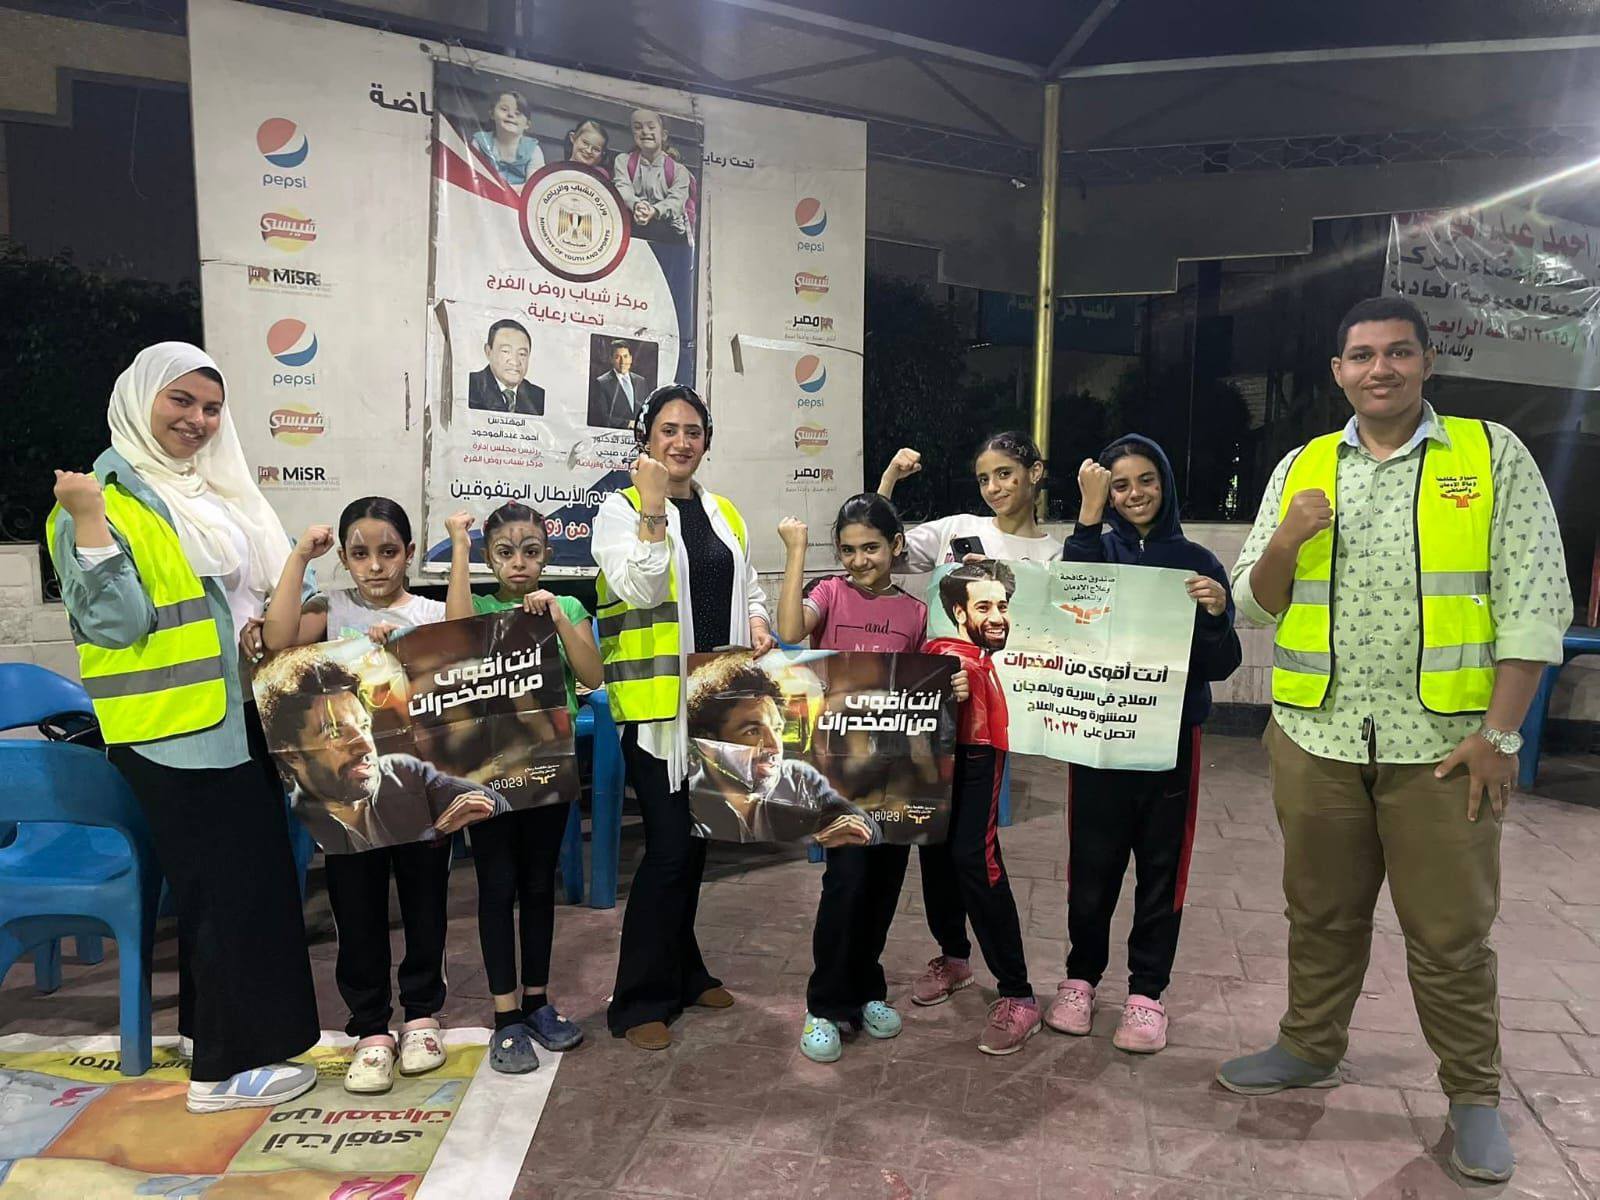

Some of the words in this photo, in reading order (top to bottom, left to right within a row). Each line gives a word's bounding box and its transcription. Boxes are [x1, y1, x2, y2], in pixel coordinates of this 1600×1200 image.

[704, 151, 726, 167] رعاي
[730, 157, 754, 168] تحت
[263, 173, 307, 189] pepsi
[797, 240, 825, 252] pepsi
[273, 268, 317, 286] MiSR
[487, 274, 525, 291] الفرج
[529, 279, 566, 299] روض
[570, 287, 611, 304] شباب
[614, 292, 648, 311] مركز
[527, 303, 566, 323] رعاية
[570, 310, 605, 326] تحت
[273, 373, 316, 387] pepsi
[797, 398, 824, 409] pepsi
[487, 417, 526, 427] المهندس
[490, 444, 516, 453] مجلس
[283, 467, 325, 480] MiSR
[451, 479, 530, 500] المتفوقين
[535, 484, 585, 506] الأبطال
[546, 519, 562, 535] ذو
[567, 522, 589, 539] من
[864, 619, 890, 635] and
[505, 643, 542, 671] أنت
[1004, 652, 1063, 671] المخدرات
[434, 651, 503, 687] أقوى
[1065, 658, 1087, 676] من
[1088, 661, 1131, 682] أقوى
[1133, 665, 1168, 683] أنت
[508, 673, 543, 699] من
[1066, 685, 1095, 701] سرية
[408, 677, 507, 717] المخدرات
[845, 689, 907, 716] أقوى
[907, 689, 942, 711] أنت
[1118, 693, 1157, 707] العلاج
[1027, 700, 1054, 713] العلاج
[1055, 705, 1088, 720] وطلب
[817, 711, 906, 736] المخدرات
[1089, 708, 1137, 724] للمشورة
[906, 715, 938, 736] من
[1083, 726, 1103, 739] على
[1104, 729, 1136, 740] اتصل
[489, 776, 523, 792] 16023
[870, 811, 900, 822] 16023
[269, 1107, 323, 1124] من
[322, 1107, 452, 1125] المخدرات
